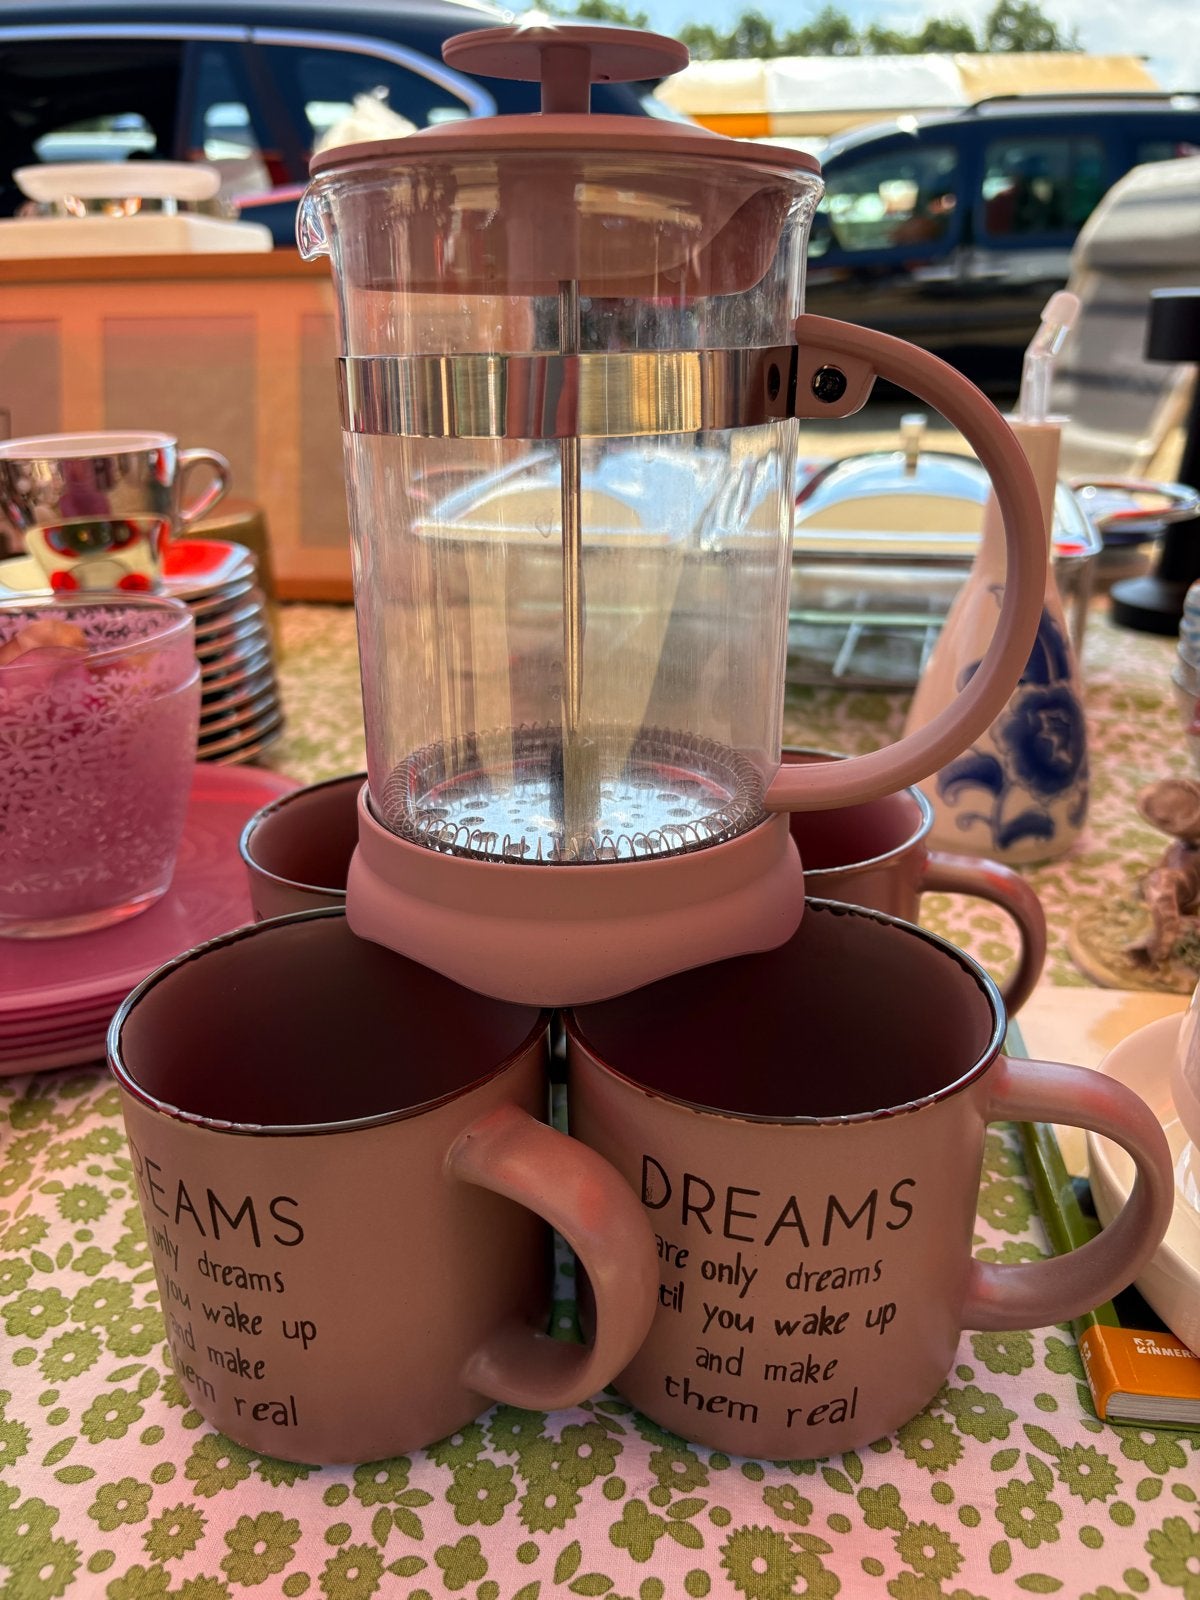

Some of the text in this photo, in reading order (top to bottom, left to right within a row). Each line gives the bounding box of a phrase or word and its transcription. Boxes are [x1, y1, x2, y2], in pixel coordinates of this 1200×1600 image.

[641, 1154, 917, 1248] DREAMS
[198, 1250, 285, 1294] dreams
[701, 1252, 758, 1299] only
[785, 1259, 883, 1292] dreams
[201, 1301, 263, 1336] wake
[282, 1319, 317, 1350] up
[657, 1281, 897, 1337] til you wake up
[172, 1341, 298, 1426] hem real
[207, 1346, 266, 1381] make
[695, 1346, 838, 1385] and make
[665, 1375, 858, 1428] them real
